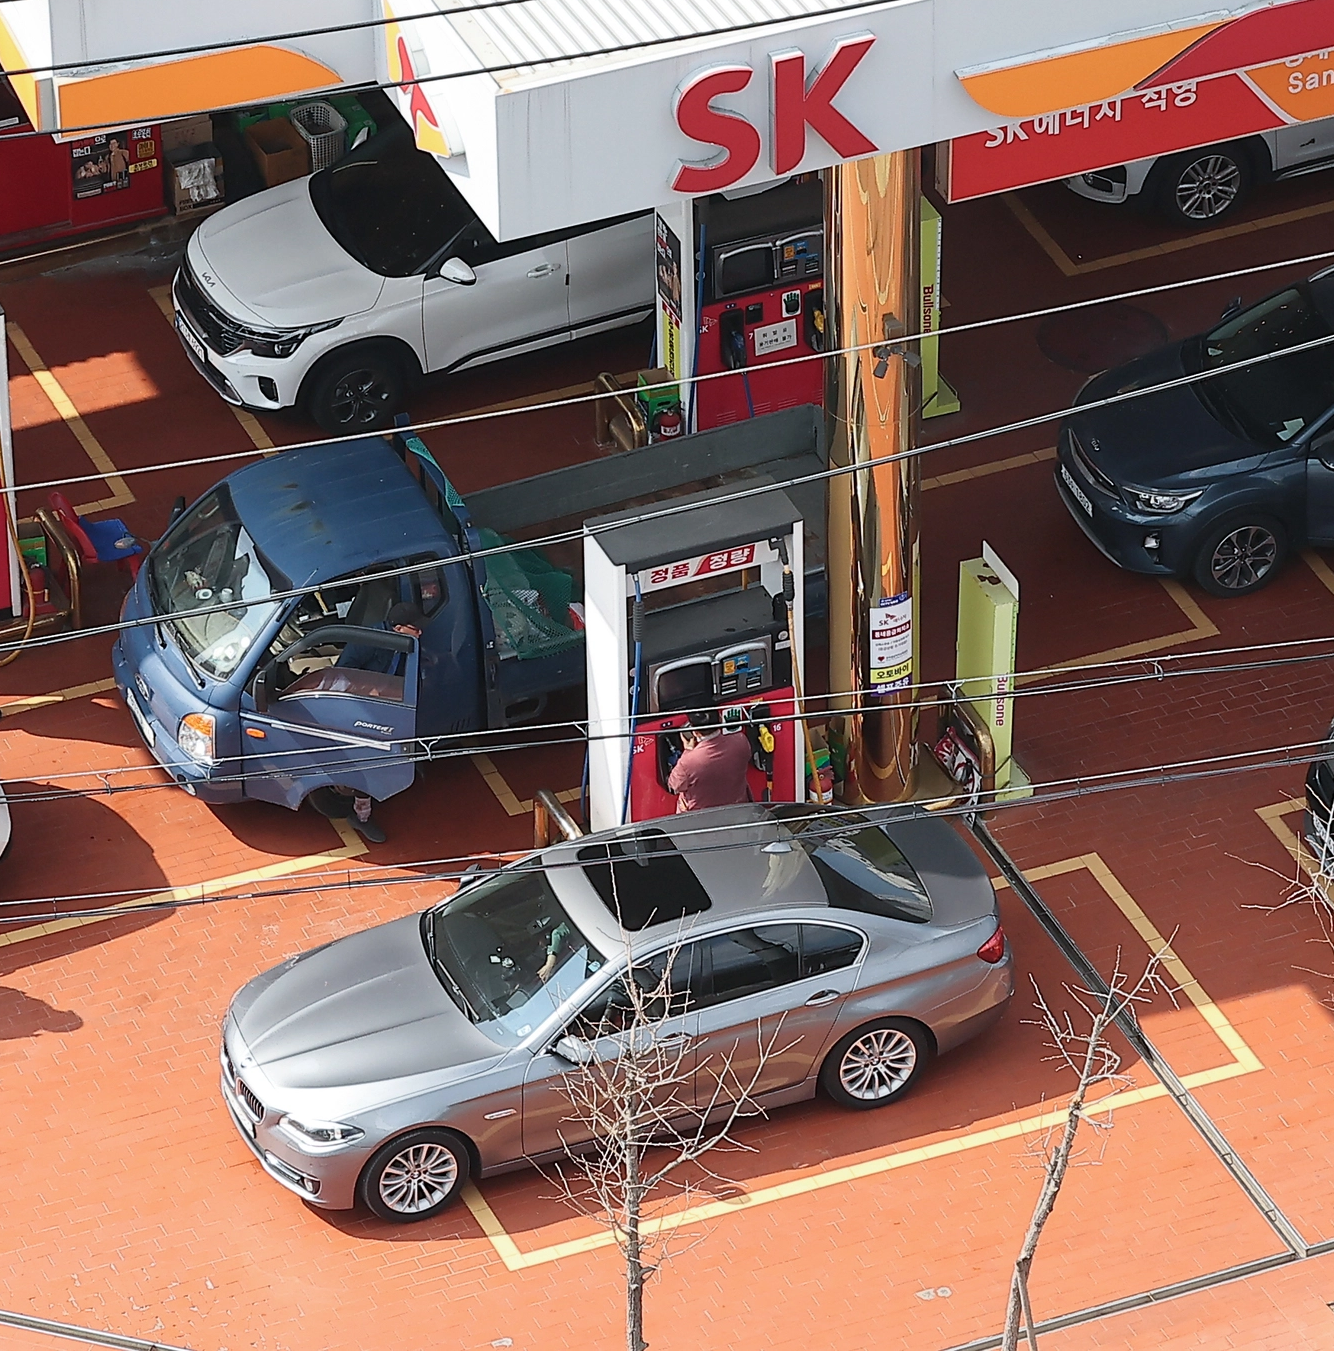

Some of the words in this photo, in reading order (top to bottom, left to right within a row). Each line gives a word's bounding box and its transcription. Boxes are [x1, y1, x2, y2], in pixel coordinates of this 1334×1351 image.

[670, 31, 880, 193] SK
[922, 285, 934, 334] Bullsone
[650, 562, 689, 584] 정품
[709, 548, 751, 569] 정량
[876, 662, 909, 679] 오토바이
[772, 723, 782, 732] 16
